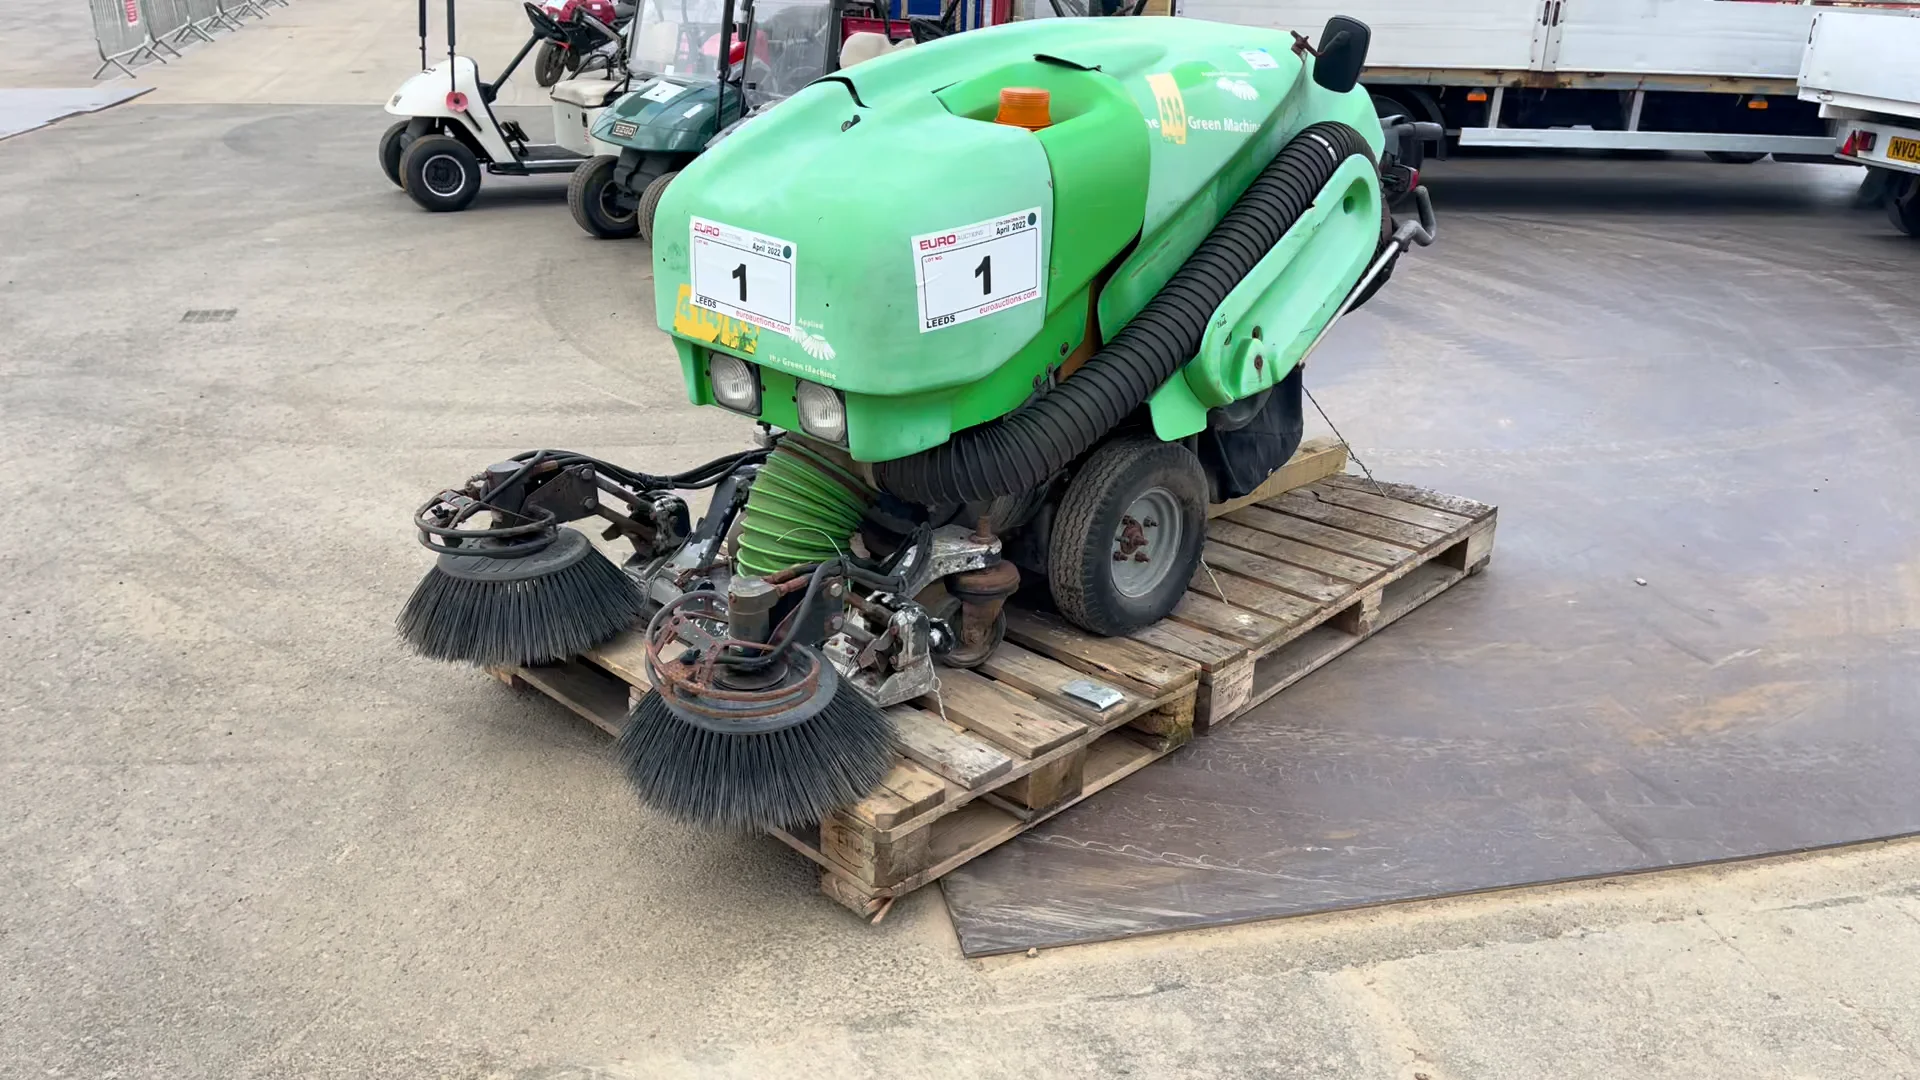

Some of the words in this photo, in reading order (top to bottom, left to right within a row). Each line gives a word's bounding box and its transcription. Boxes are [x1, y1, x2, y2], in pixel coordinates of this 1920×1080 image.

[1187, 115, 1222, 131] Green
[694, 222, 720, 237] EURO
[996, 225, 1010, 236] April
[1012, 221, 1026, 231] 2022
[752, 242, 766, 253] April
[767, 246, 781, 257] 2022
[919, 234, 956, 251] EURO
[732, 263, 747, 302] 1
[974, 255, 991, 296] 1
[695, 295, 717, 309] LEEDS
[979, 290, 1037, 314] euroauctions.com
[735, 310, 791, 334] euroauctions.com
[798, 317, 824, 330] Applied
[926, 314, 956, 329] LEEDS
[782, 357, 804, 371] Green
[804, 364, 837, 380] Machine
